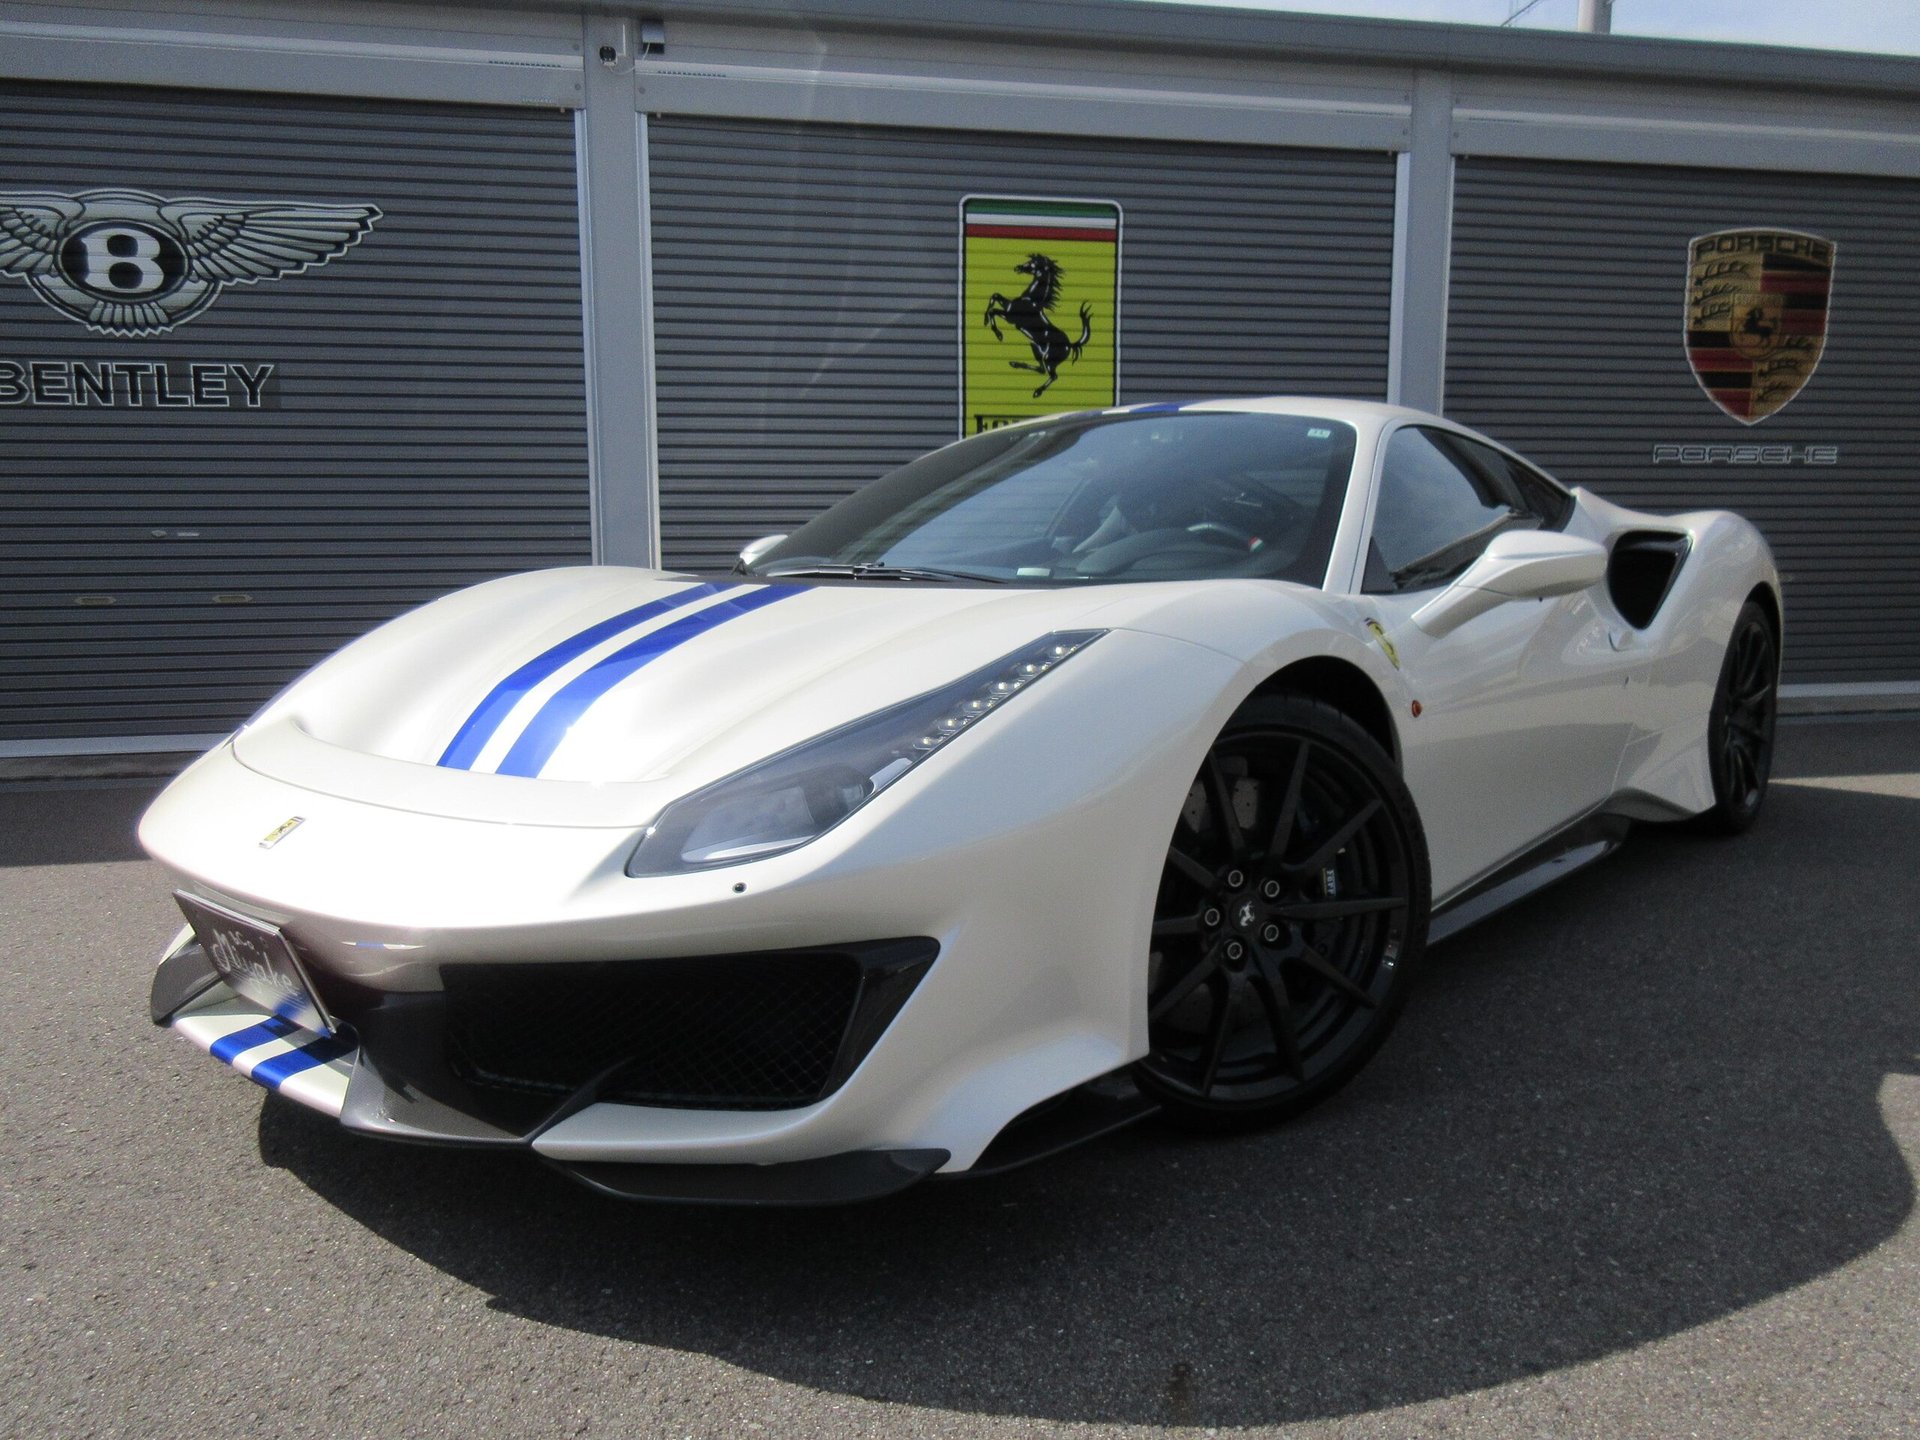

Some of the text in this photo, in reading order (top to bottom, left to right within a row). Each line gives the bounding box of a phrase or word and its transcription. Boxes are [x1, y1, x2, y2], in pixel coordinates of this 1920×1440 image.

[81, 227, 165, 294] B
[1695, 235, 1831, 264] PORSCHE
[0, 360, 275, 407] BENTLEY
[1653, 445, 1837, 464] PORSCHE
